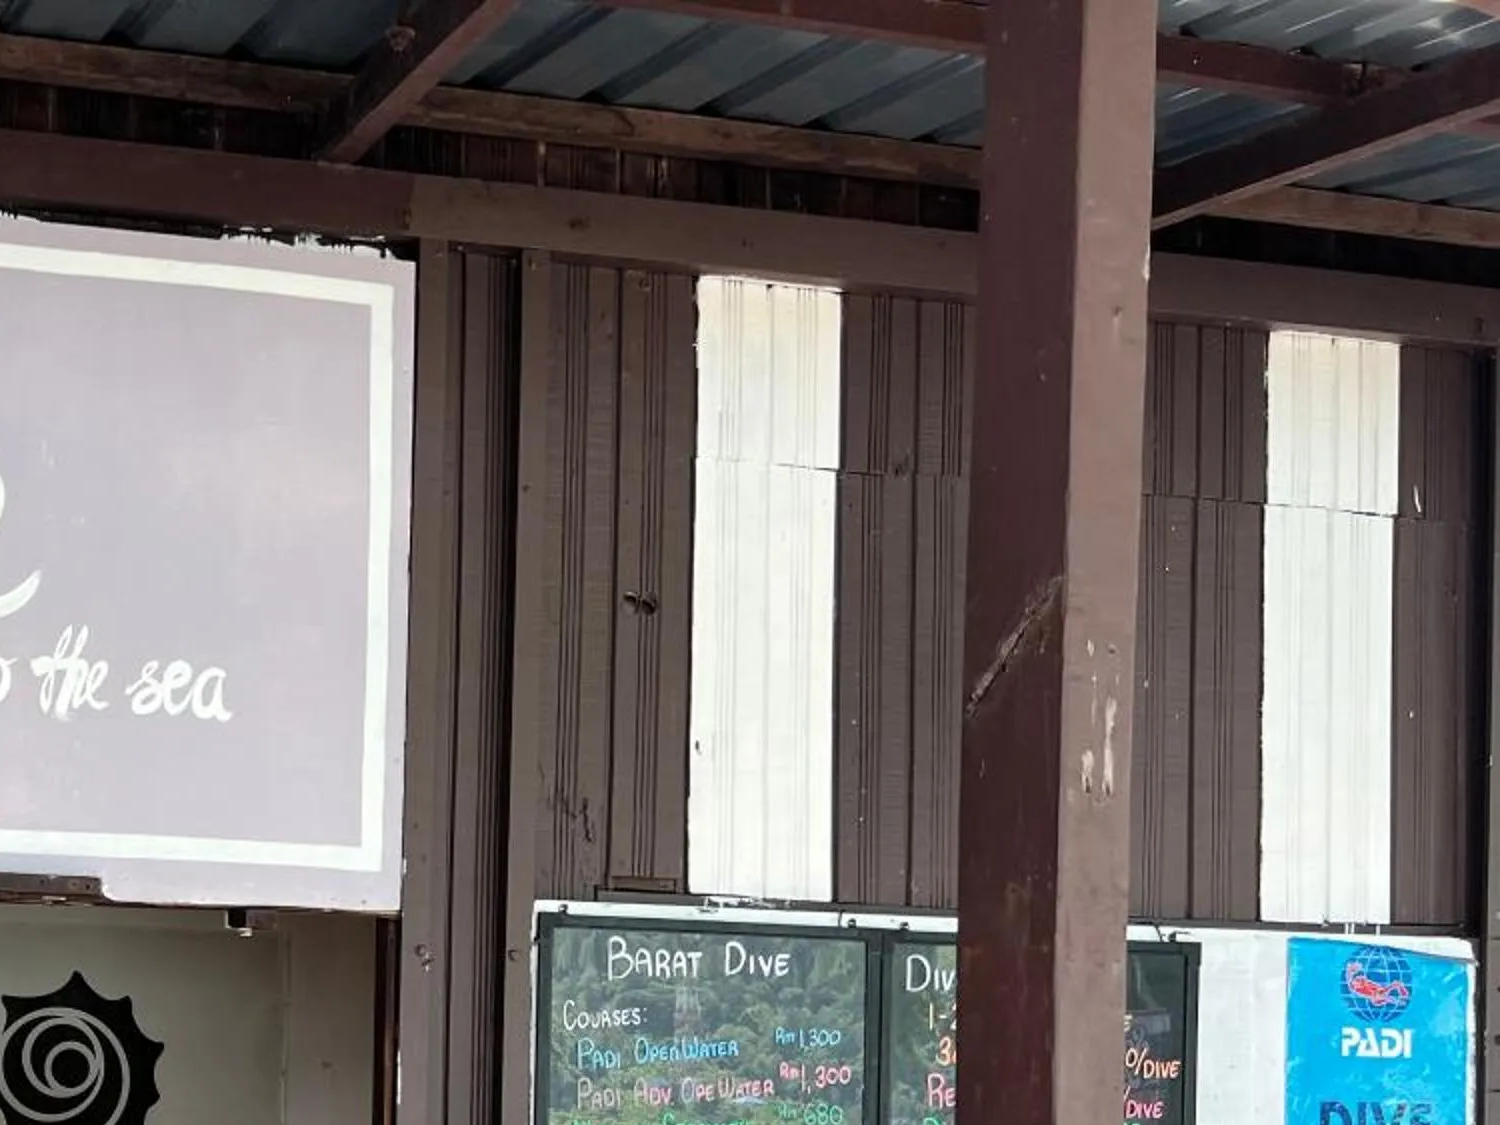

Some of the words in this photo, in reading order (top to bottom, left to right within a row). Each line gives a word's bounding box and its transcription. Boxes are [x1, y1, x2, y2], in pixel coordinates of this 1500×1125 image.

[30, 623, 110, 721] the
[125, 659, 233, 722] sea
[607, 935, 702, 981] BARAT
[724, 941, 791, 977] DIVE
[905, 953, 956, 993] DIV
[577, 1038, 621, 1069] PADI
[1340, 1026, 1413, 1059] PADI
[577, 1077, 622, 1109] PADI
